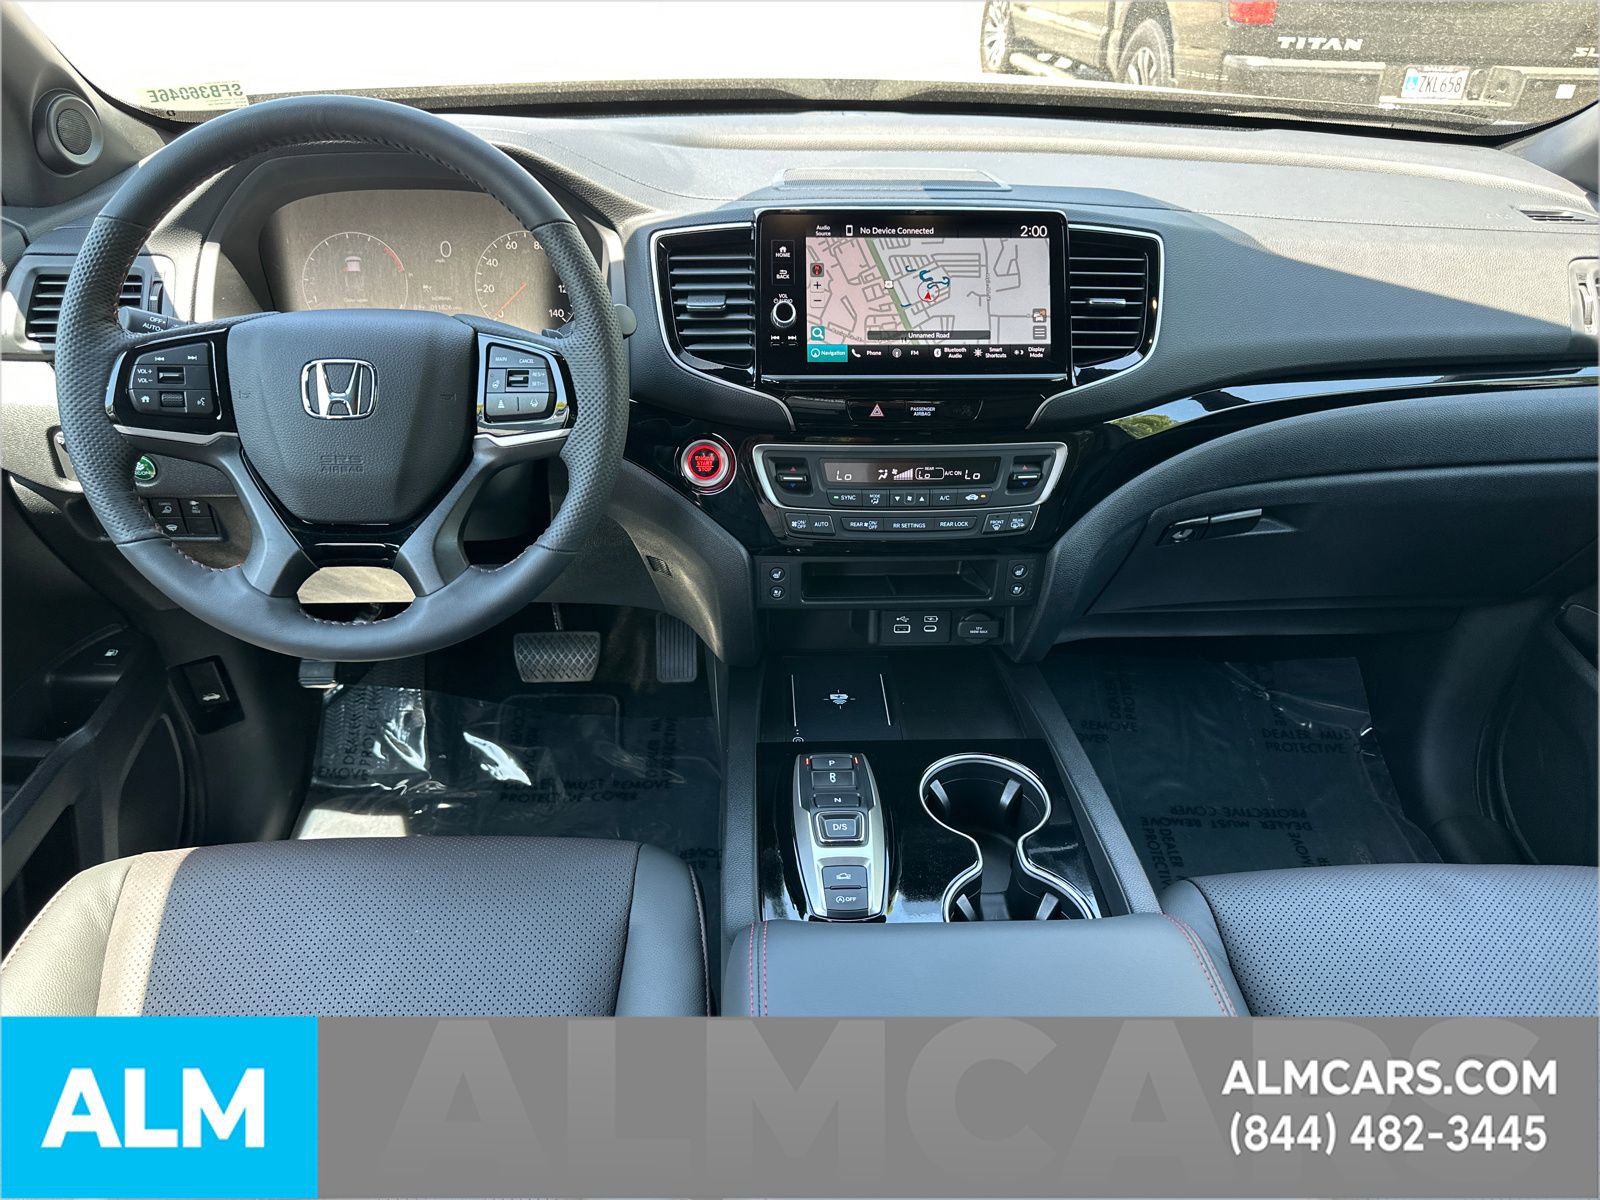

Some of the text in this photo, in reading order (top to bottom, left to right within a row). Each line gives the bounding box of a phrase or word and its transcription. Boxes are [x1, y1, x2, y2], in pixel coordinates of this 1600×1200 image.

[1277, 36, 1363, 51] TITAN
[1418, 75, 1463, 93] ZKL658
[860, 226, 934, 235] No Device Connected
[1020, 225, 1048, 237] 2:00
[439, 240, 452, 258] 0
[505, 241, 518, 250] 60
[486, 258, 499, 268] 40
[482, 284, 495, 293] 20
[558, 284, 567, 293] 12
[548, 308, 565, 318] 140
[149, 316, 162, 324] OFF
[142, 322, 161, 332] AUTO
[320, 465, 364, 474] AIRBAG
[1076, 732, 1111, 745] OVER
[1262, 727, 1313, 740] DEALER
[1264, 741, 1348, 754] PROTECTIVE
[319, 767, 370, 780] EMOVE
[612, 778, 673, 790] REMOVE
[1168, 804, 1308, 819] PROTECTIVE COVER
[832, 823, 848, 831] D/S
[1139, 815, 1313, 832] DEALER MUST REMOVE
[1158, 827, 1185, 868] DEALER
[1143, 826, 1173, 890] PROTECTIV
